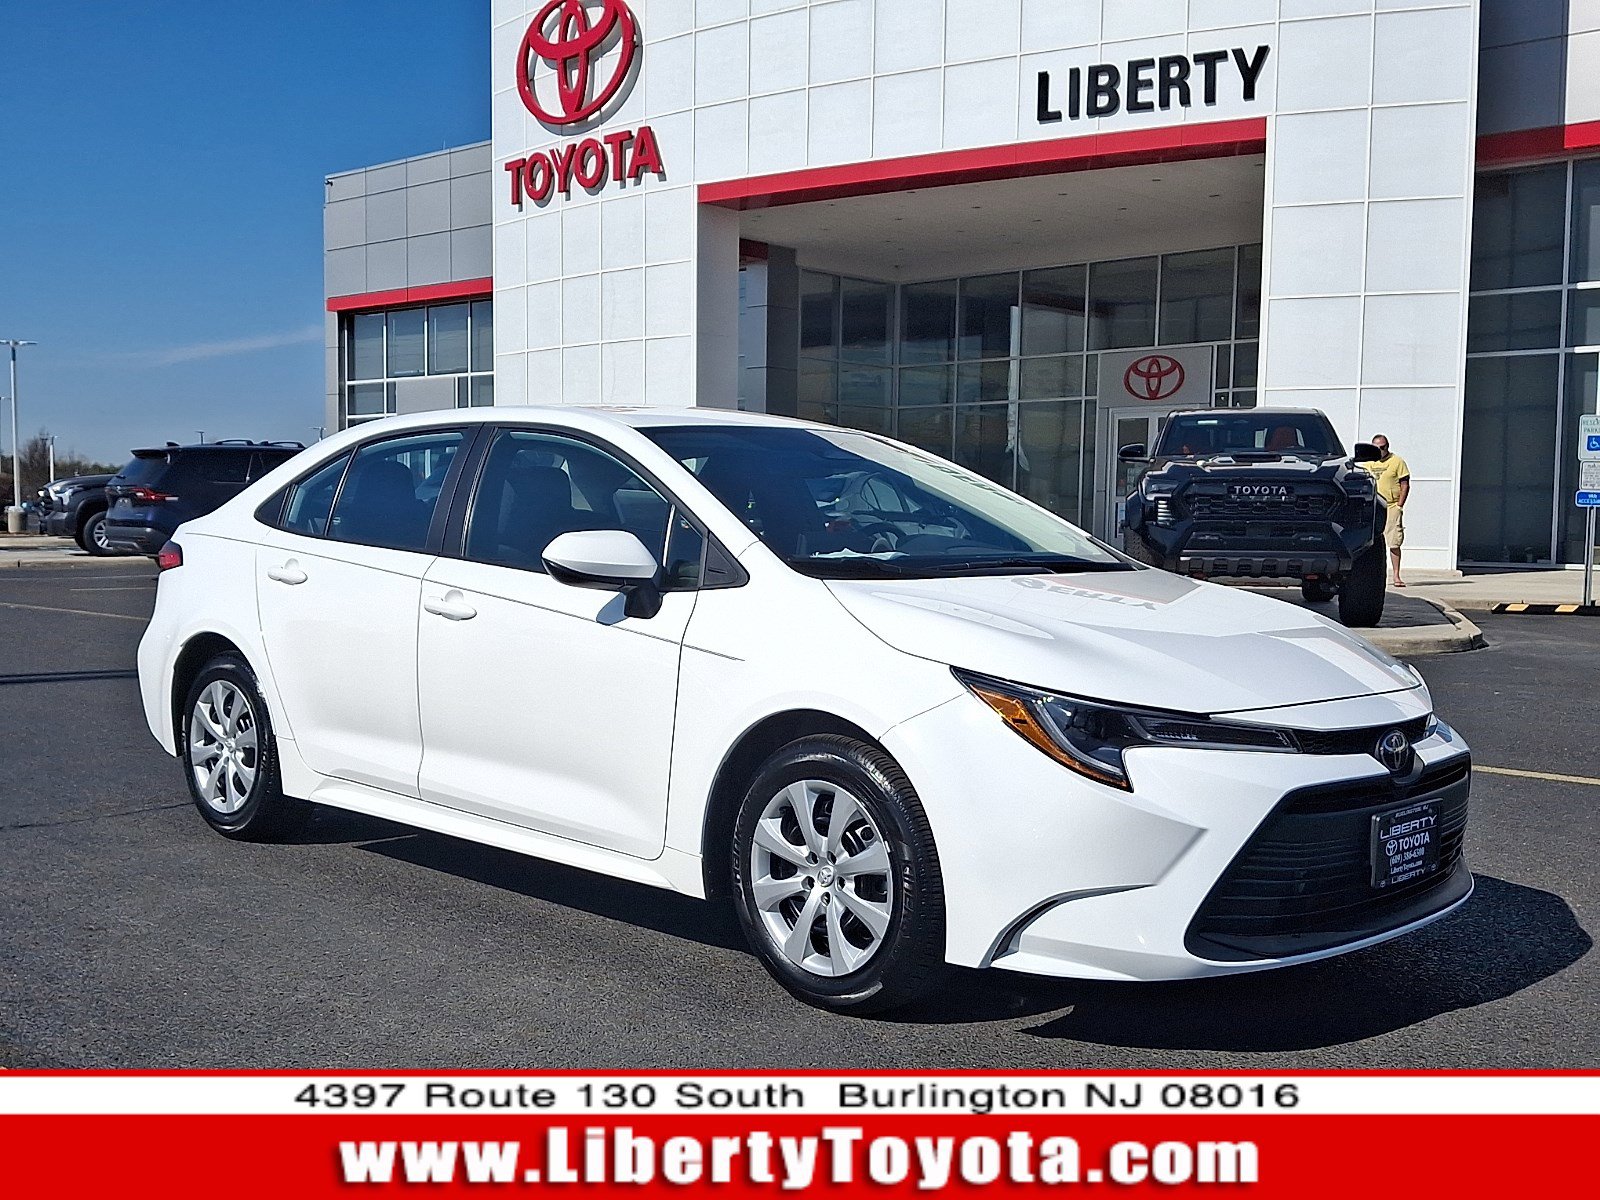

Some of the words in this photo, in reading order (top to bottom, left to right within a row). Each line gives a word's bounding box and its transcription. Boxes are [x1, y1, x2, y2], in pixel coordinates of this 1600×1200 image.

[1037, 45, 1271, 124] LIBERTY
[505, 126, 665, 208] TOYOTA
[1233, 485, 1287, 495] TOYOTA
[1380, 814, 1437, 839] LIBERTY
[1399, 831, 1430, 851] TOYOTA
[1391, 868, 1425, 883] LIBERTY
